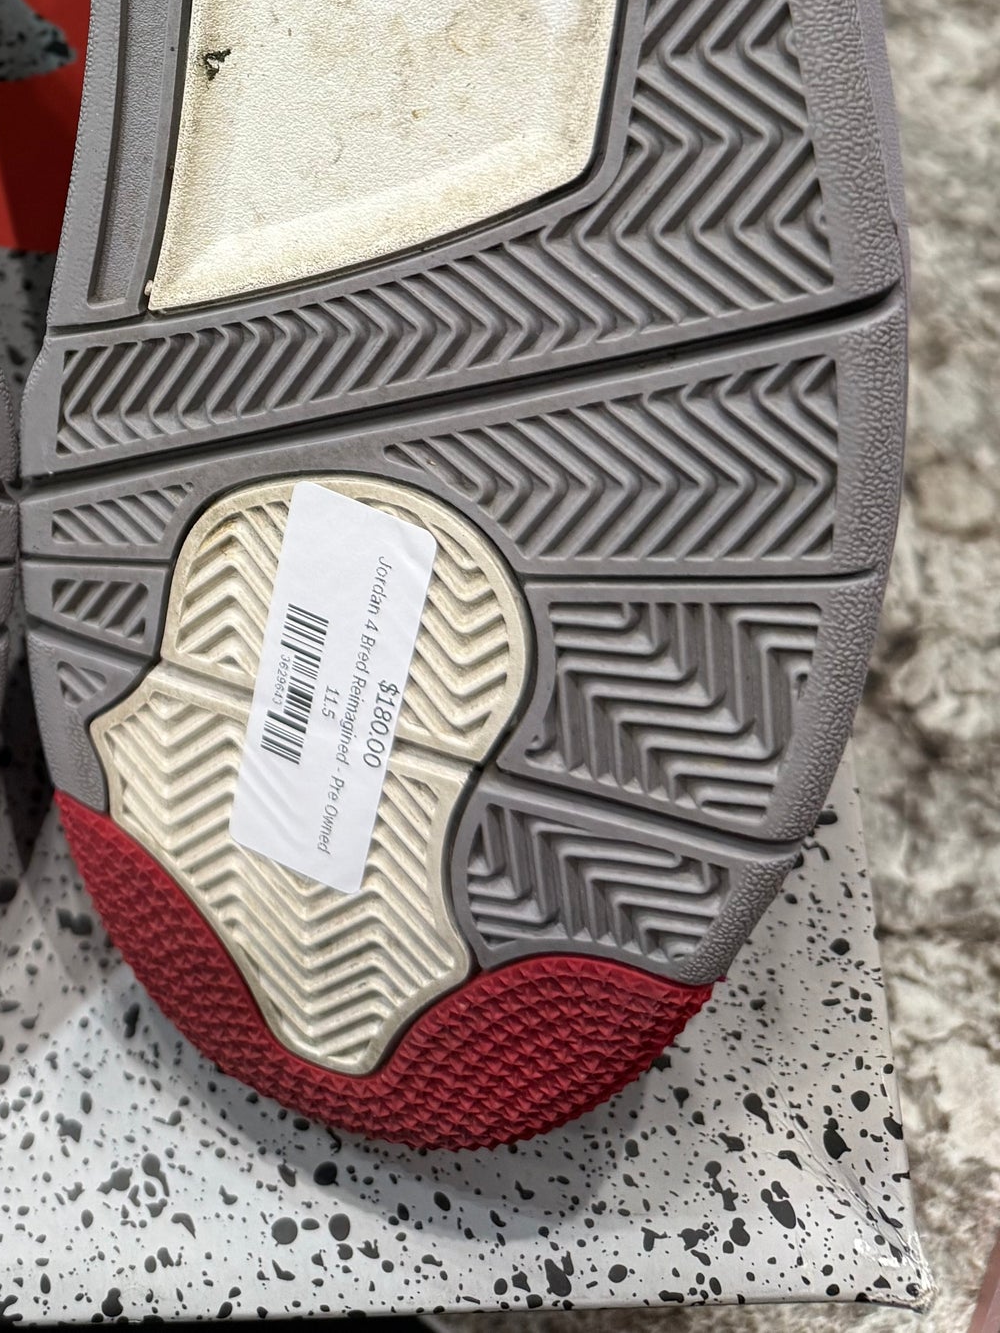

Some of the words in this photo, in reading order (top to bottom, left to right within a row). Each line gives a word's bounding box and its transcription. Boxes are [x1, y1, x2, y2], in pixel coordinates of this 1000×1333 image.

[368, 556, 392, 615] Jordan
[365, 619, 379, 632] 4
[355, 633, 376, 675] Bred
[321, 685, 340, 719] 11.5
[337, 673, 366, 765] Reimagined
[363, 680, 400, 768] $180.00
[329, 775, 345, 801] Pre
[317, 805, 339, 855] Owned
